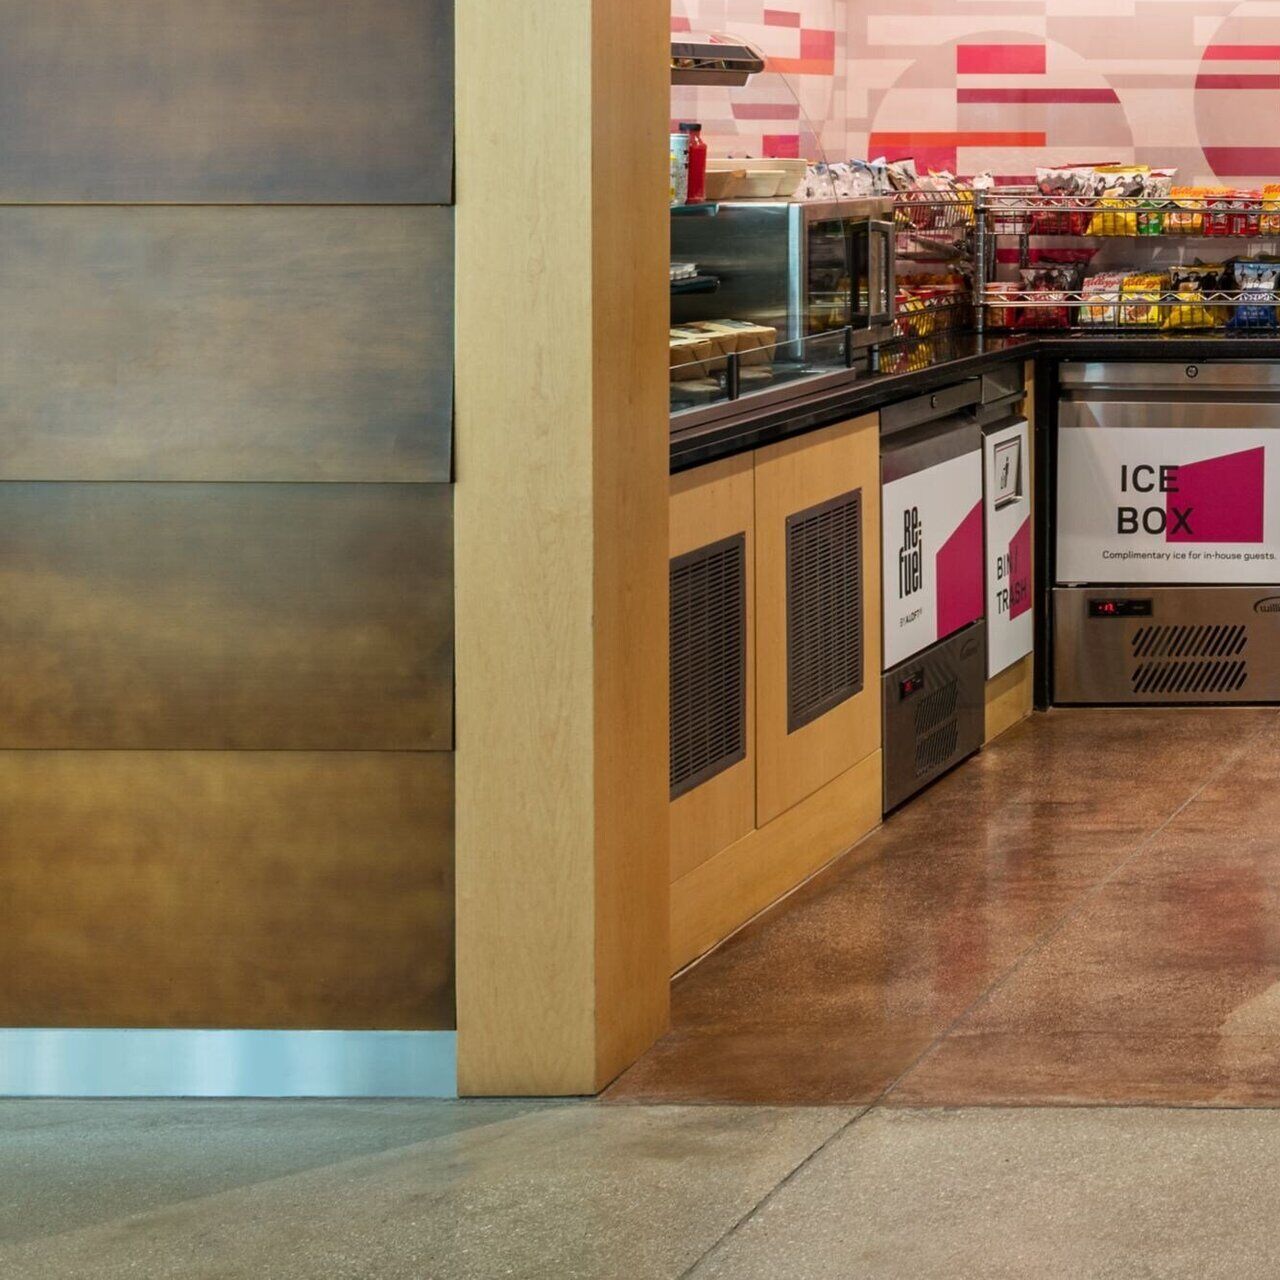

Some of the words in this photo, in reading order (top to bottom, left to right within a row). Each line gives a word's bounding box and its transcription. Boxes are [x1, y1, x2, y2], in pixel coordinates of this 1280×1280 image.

[1121, 464, 1180, 493] ICE
[1117, 506, 1194, 535] BOX
[997, 553, 1012, 581] BIN
[1101, 550, 1171, 562] Complimentary
[1173, 551, 1187, 560] ice
[1188, 550, 1201, 560] for
[1203, 551, 1242, 560] in-house
[1243, 552, 1277, 562] guests.
[996, 581, 1027, 614] TRASH
